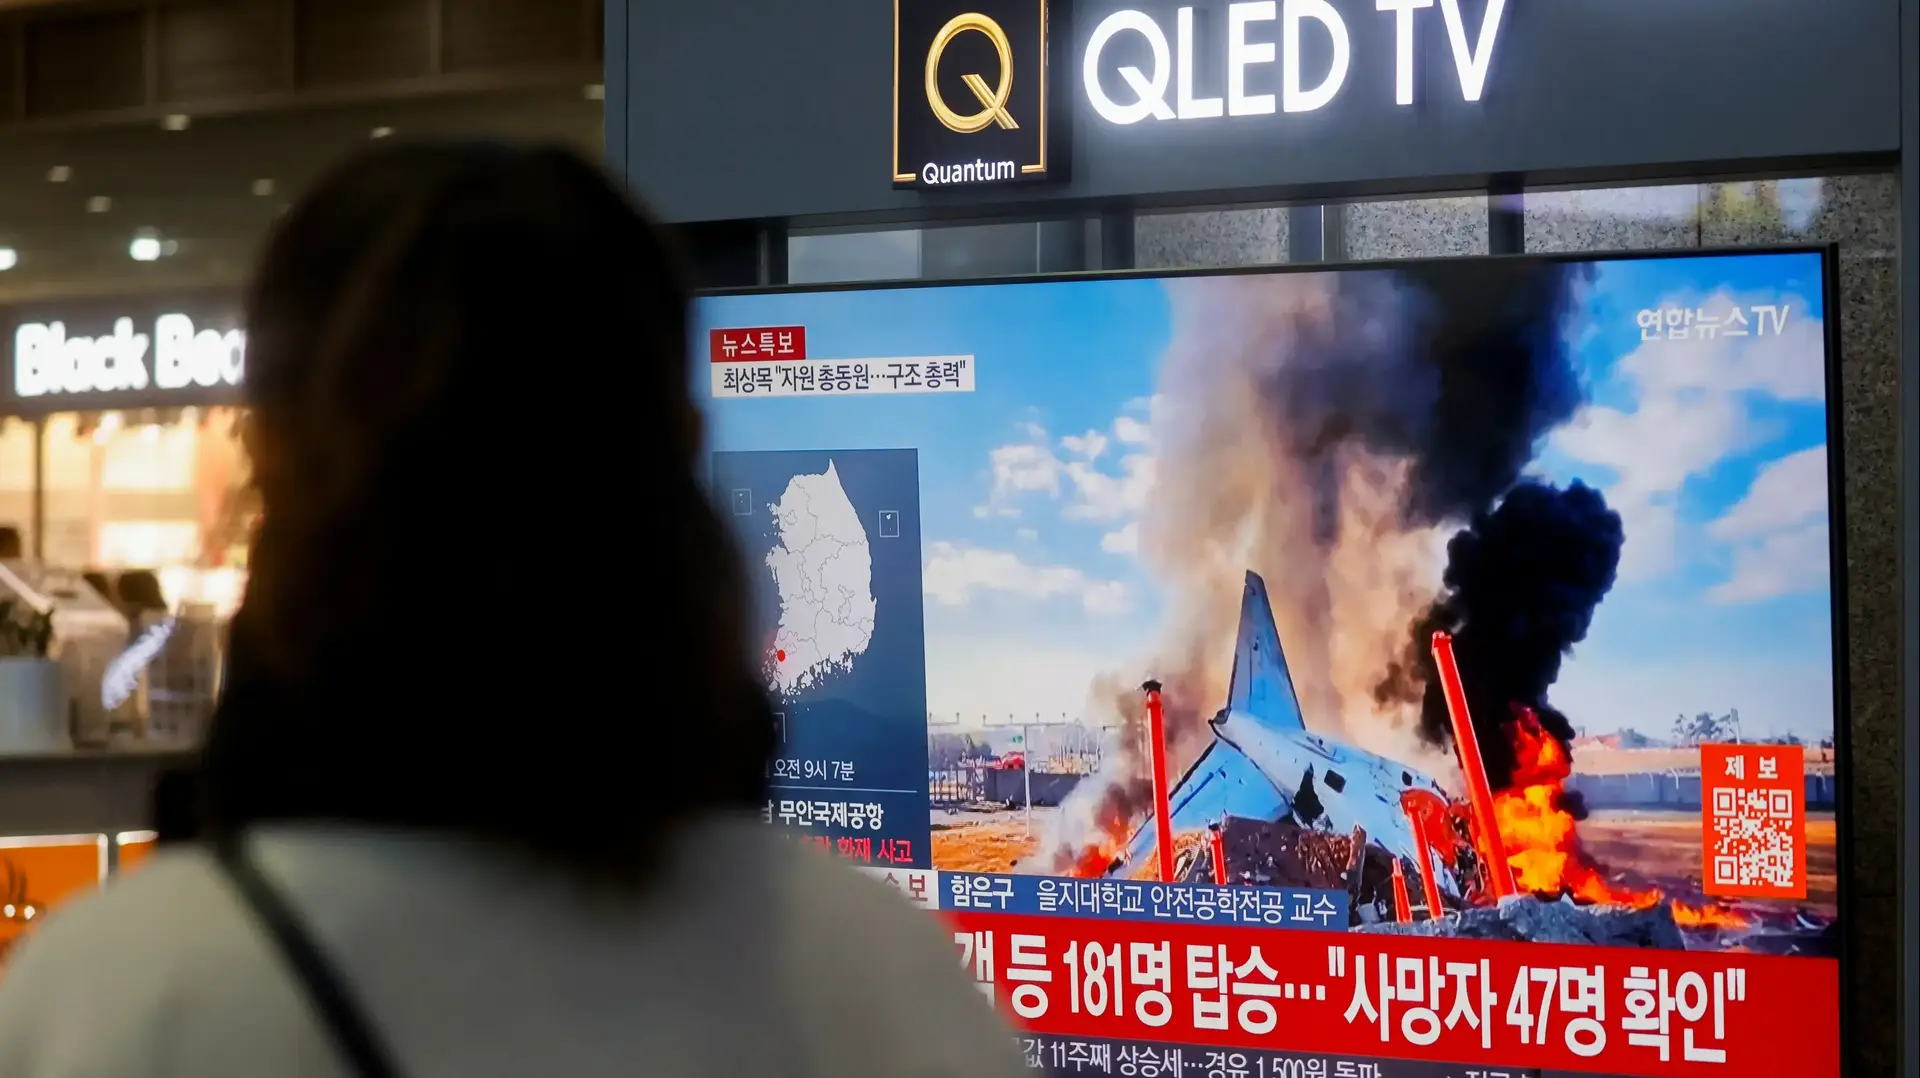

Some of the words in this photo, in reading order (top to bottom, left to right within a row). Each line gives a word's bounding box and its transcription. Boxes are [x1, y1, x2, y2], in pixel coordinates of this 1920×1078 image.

[925, 12, 1020, 134] Q
[1083, 0, 1350, 125] QLED
[1376, 0, 1503, 105] TV
[922, 158, 1015, 185] Quantum
[15, 316, 150, 397] Black
[722, 331, 795, 358] 뉴스특보
[723, 366, 773, 393] 최상목
[775, 365, 815, 392] "자원
[925, 359, 967, 389] 총력"
[773, 758, 801, 780] 오전
[804, 759, 827, 780] 9시
[831, 760, 855, 781] 7분
[778, 800, 885, 830] 무안국제공항
[877, 838, 914, 864] 사고
[950, 875, 1015, 910] 함은구
[1036, 879, 1145, 916] 을지대학교
[1150, 885, 1285, 925] 안전공학전공
[1290, 893, 1338, 927] 교수
[1006, 934, 1053, 1019] 등
[1062, 939, 1173, 1028] 181명
[1505, 964, 1607, 1058] 47명
[1620, 966, 1746, 1064] 확인"
[1050, 1040, 1112, 1074] 11주째
